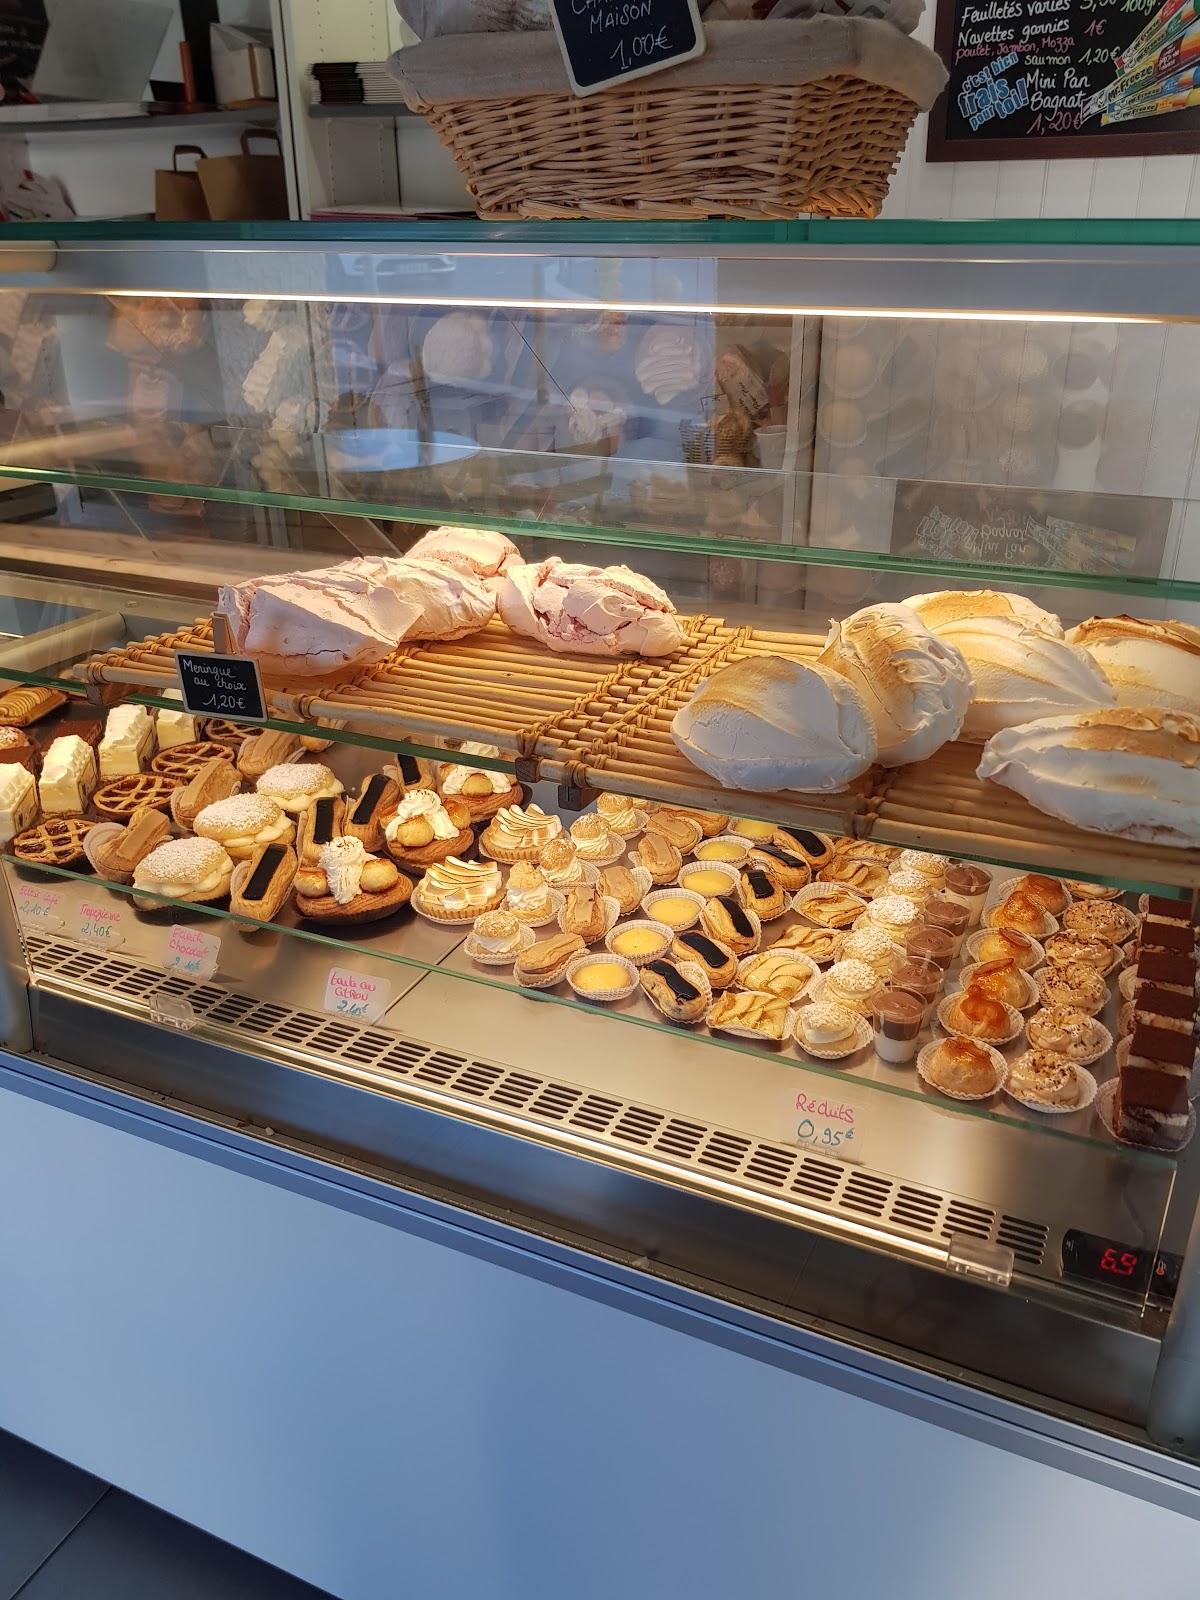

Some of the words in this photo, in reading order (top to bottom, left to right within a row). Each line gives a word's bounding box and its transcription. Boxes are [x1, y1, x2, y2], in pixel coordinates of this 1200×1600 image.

[961, 1, 1022, 27] Feuilletés
[957, 26, 1014, 47] Navettes
[1019, 19, 1069, 44] garnies
[1084, 18, 1107, 37] 1€
[1041, 36, 1076, 53] Mozza
[990, 51, 1019, 76] bien
[1024, 54, 1071, 66] saumon
[1078, 46, 1120, 66] 1,20€
[1027, 67, 1056, 91] Mini
[1063, 67, 1090, 90] Pan
[958, 78, 1009, 118] frais
[969, 105, 996, 131] pour
[995, 78, 1029, 119] toi!
[1030, 91, 1086, 121] Bagnat
[182, 658, 237, 681] Meringue
[194, 676, 211, 687] au
[216, 677, 247, 691] choix
[203, 693, 246, 709] 1,20€
[795, 1092, 855, 1124] Réduits
[797, 1119, 856, 1147] 0,95€
